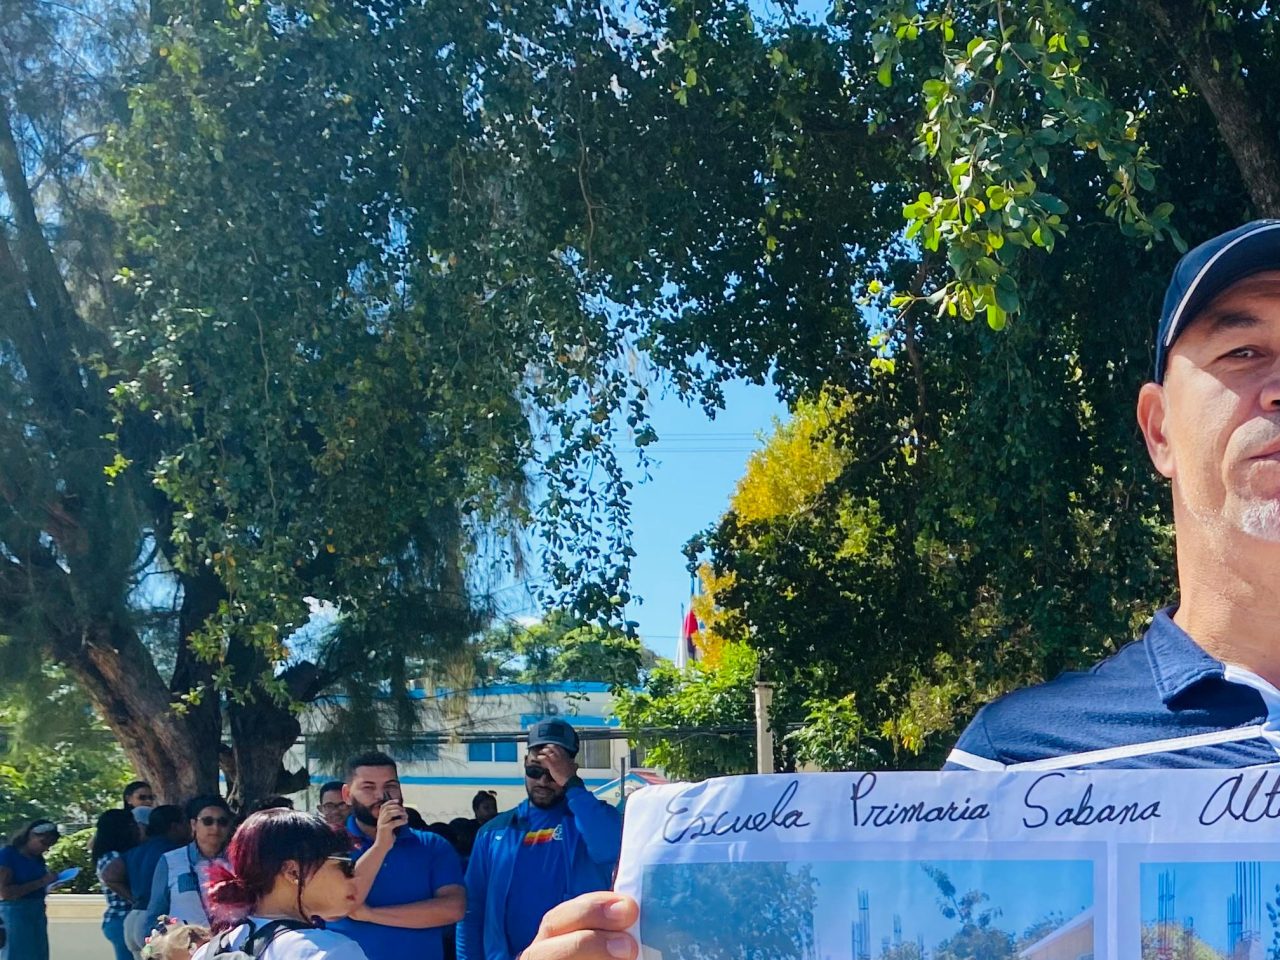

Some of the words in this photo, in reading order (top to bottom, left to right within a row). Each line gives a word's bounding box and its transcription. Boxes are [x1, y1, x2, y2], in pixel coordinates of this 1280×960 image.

[662, 774, 811, 845] Escuela
[850, 772, 991, 828] Primaria
[1022, 774, 1161, 829] Sabana
